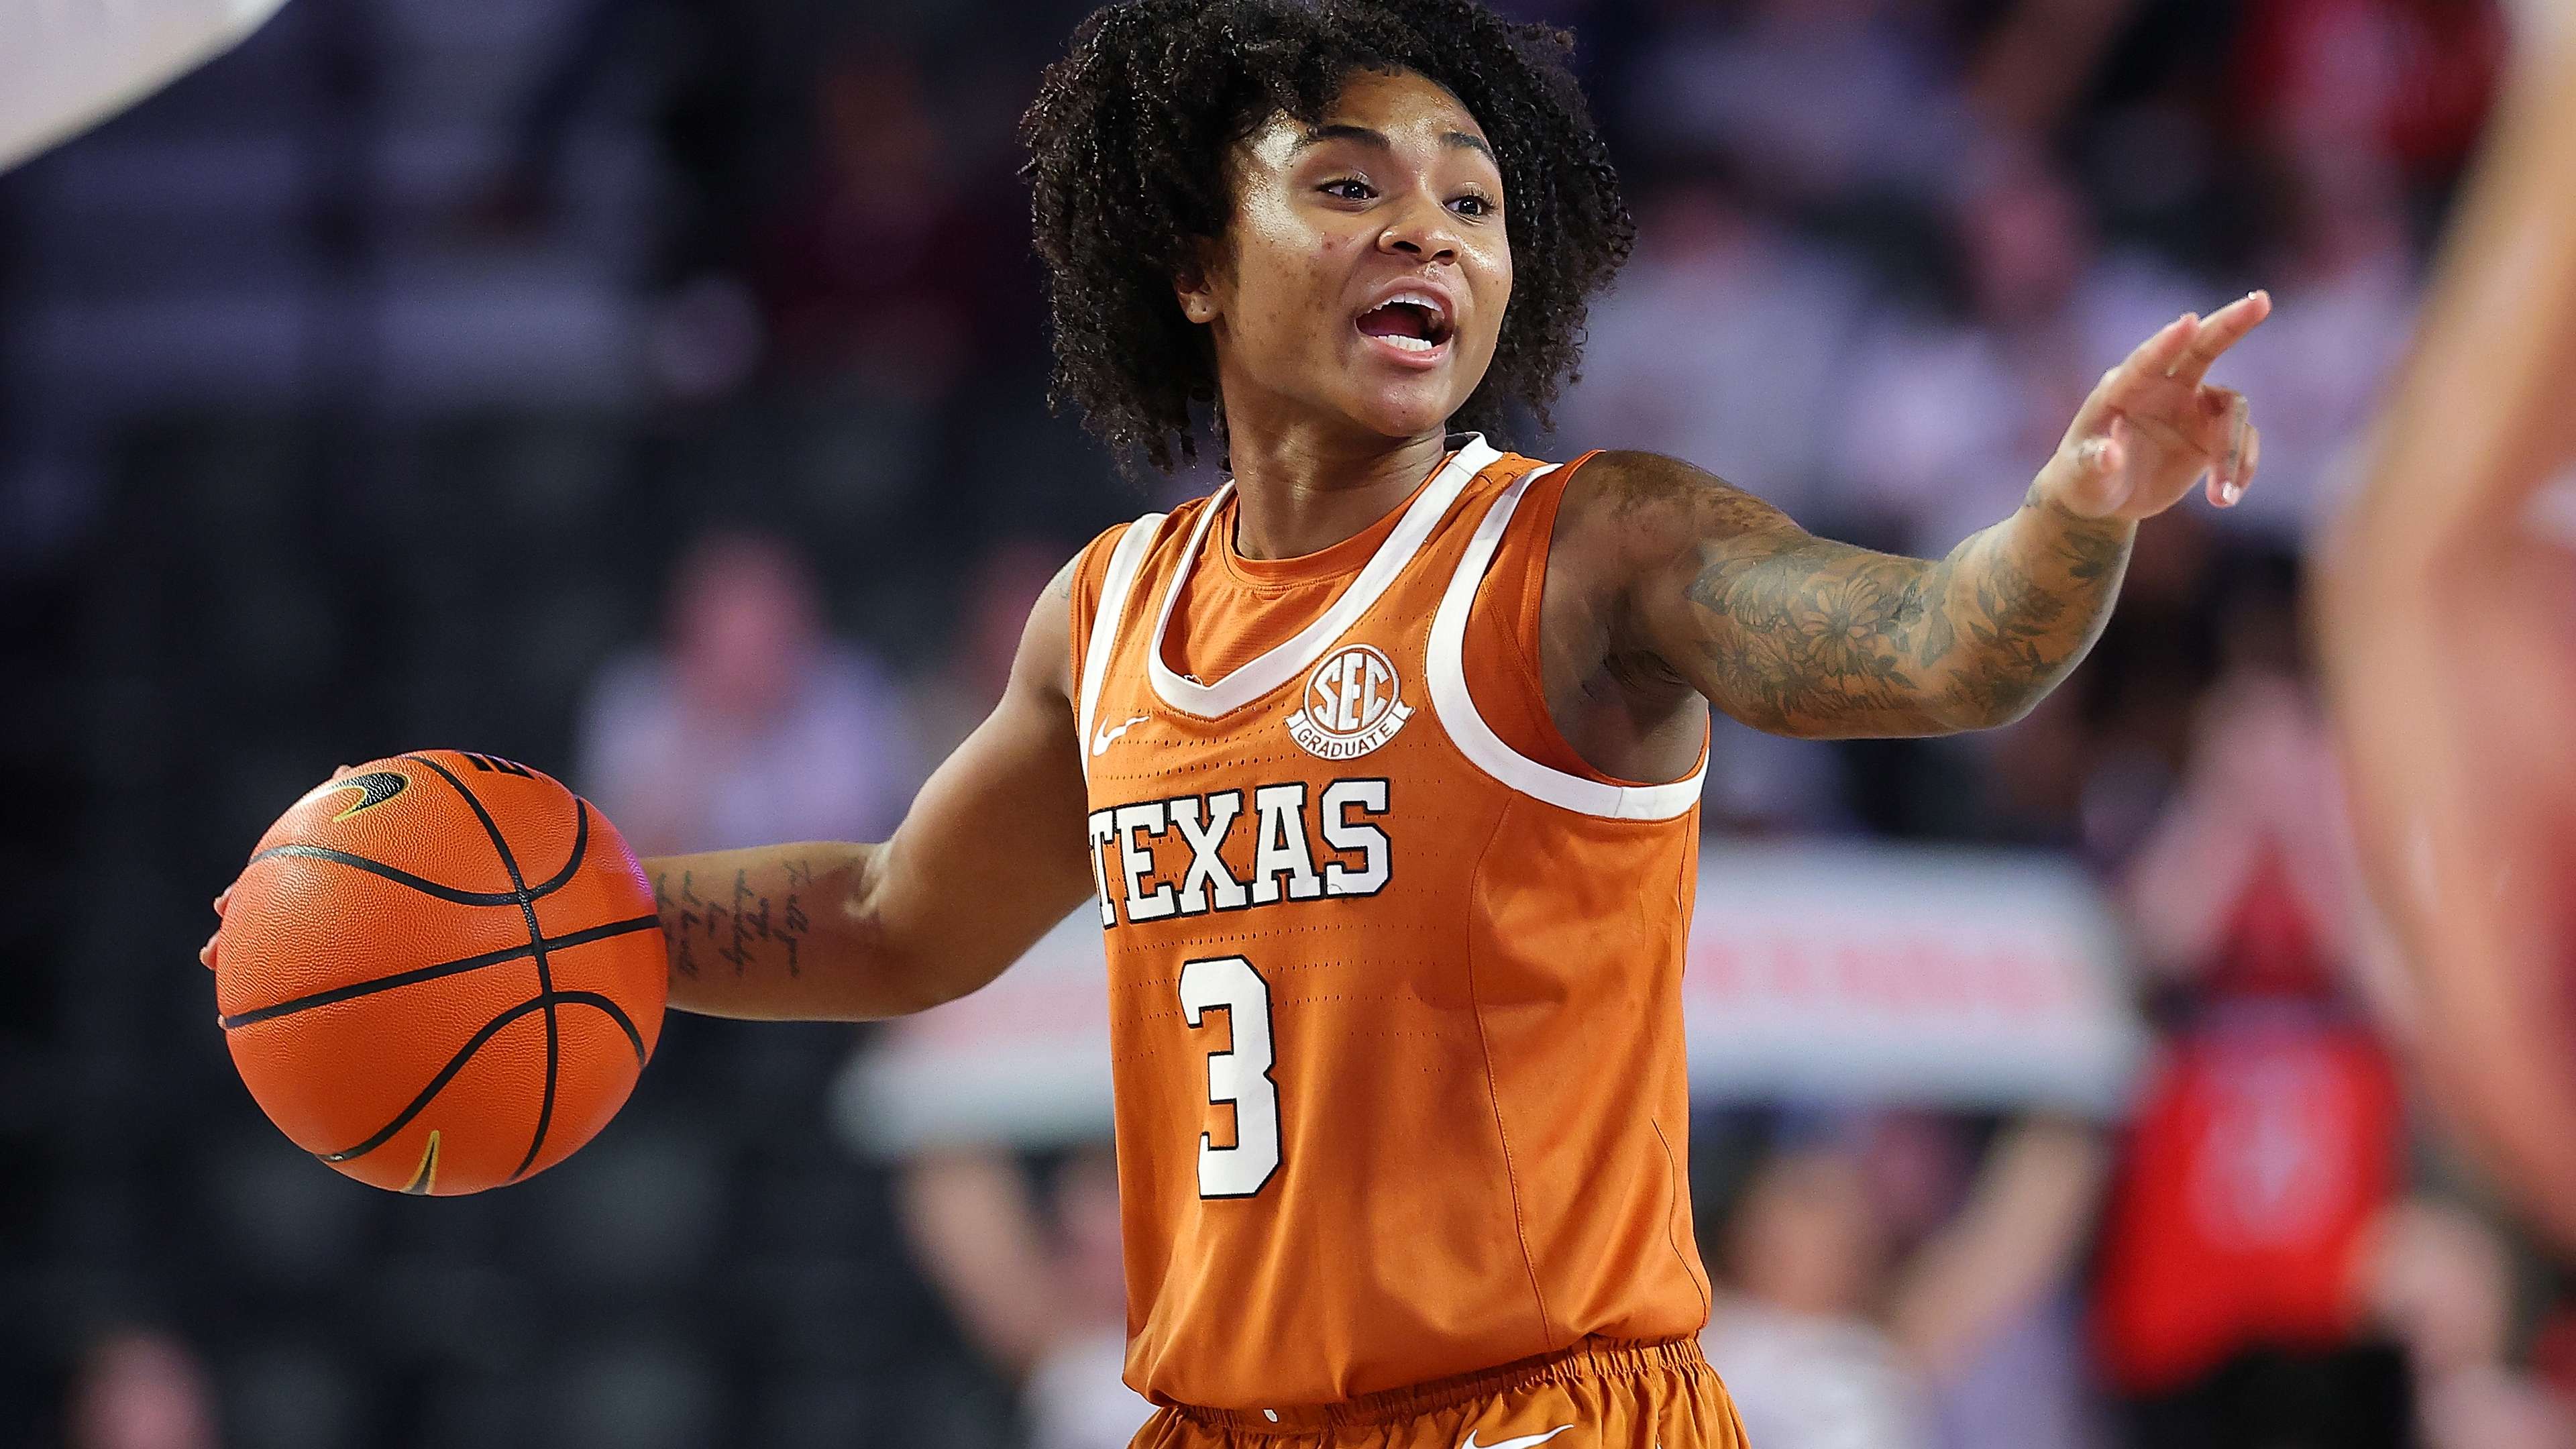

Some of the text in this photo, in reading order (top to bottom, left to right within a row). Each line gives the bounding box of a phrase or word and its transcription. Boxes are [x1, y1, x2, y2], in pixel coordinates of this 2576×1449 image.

[1297, 723, 1394, 758] GRADUATE
[1313, 652, 1390, 732] SEC
[1088, 777, 1393, 930] TEXAS
[1178, 954, 1284, 1200] 3
